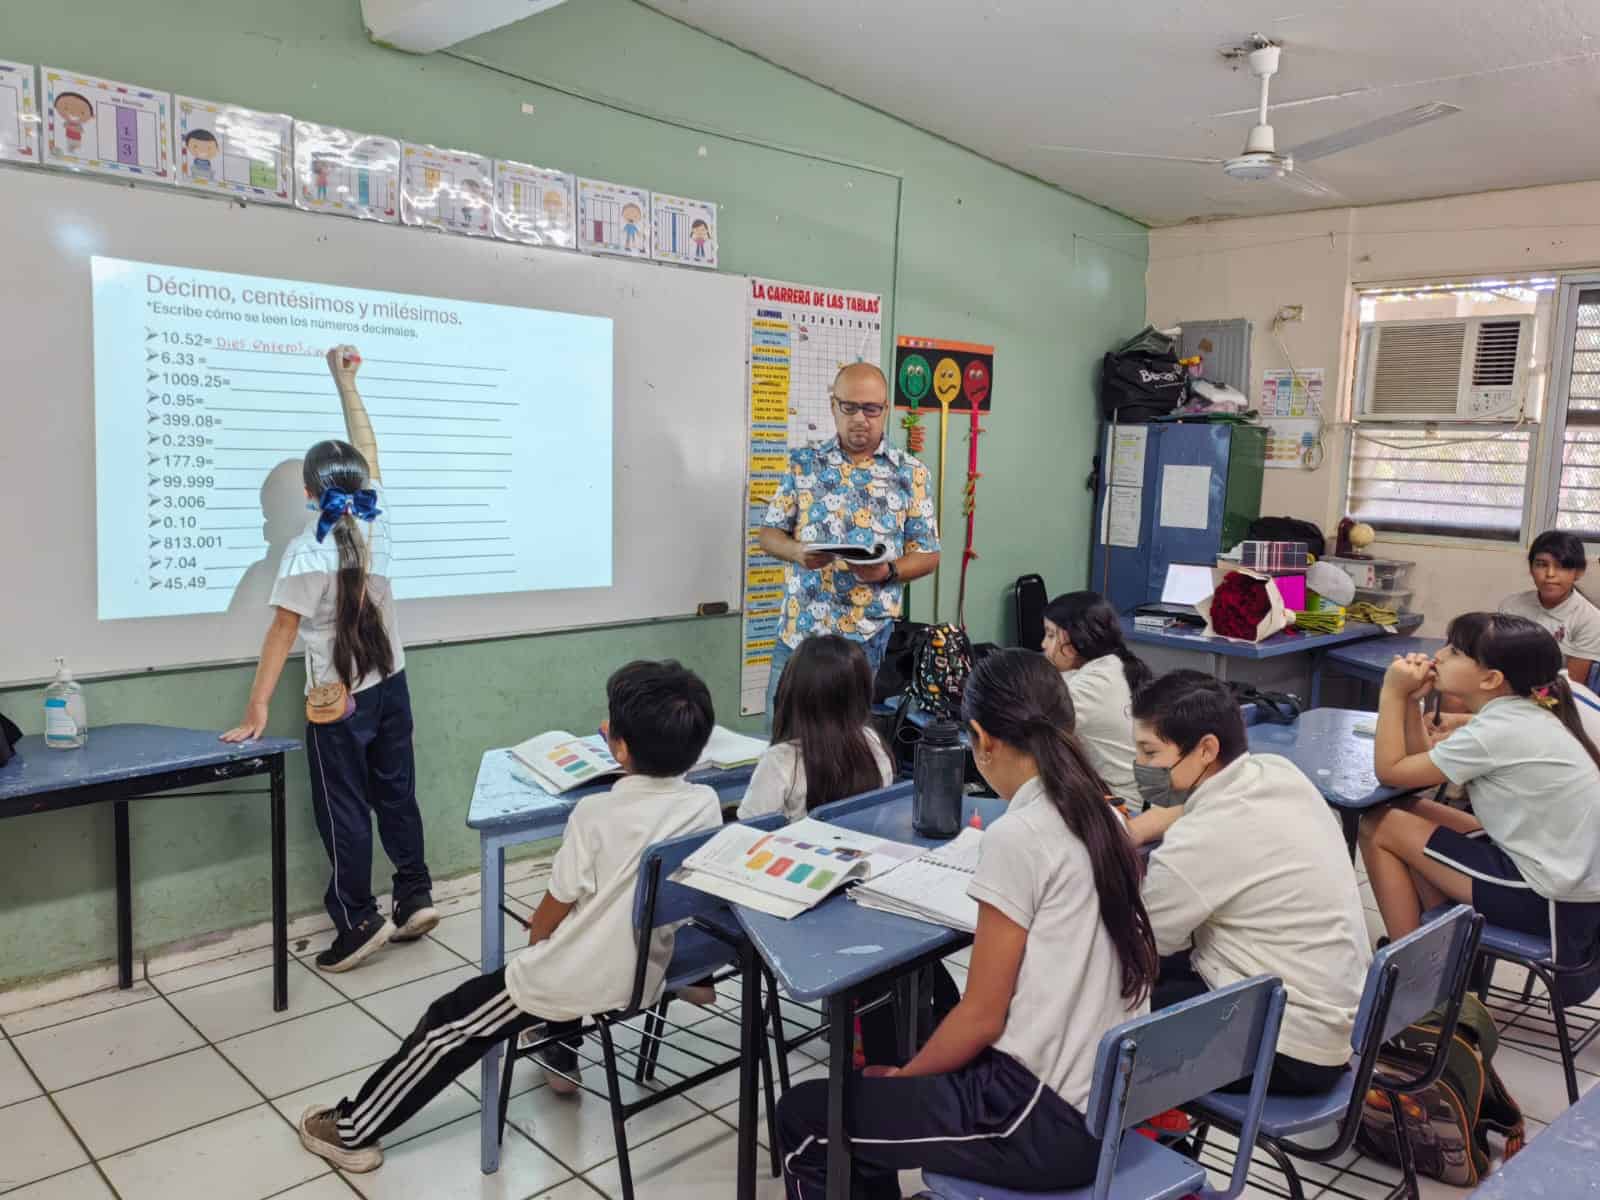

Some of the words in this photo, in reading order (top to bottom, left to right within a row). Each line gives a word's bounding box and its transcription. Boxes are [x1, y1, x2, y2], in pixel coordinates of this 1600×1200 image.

[146, 275, 236, 304] Décimo,
[242, 288, 355, 314] centésimos
[359, 301, 369, 319] y
[373, 301, 463, 325] milésimos.
[753, 284, 766, 300] LA
[767, 286, 810, 306] CARRERA
[813, 292, 825, 307] DE
[827, 294, 844, 310] LAS
[846, 297, 878, 313] TABLAS
[205, 308, 241, 321] cómo
[244, 314, 260, 323] se
[262, 312, 288, 326] leen
[290, 315, 309, 327] los
[311, 316, 360, 332] números
[362, 322, 419, 338] decimales.
[162, 331, 212, 347] 10.52=
[162, 352, 194, 366] 6.33
[162, 372, 231, 389] 1009.25=
[162, 392, 204, 408] 0.95=
[162, 412, 223, 428] 399.08=
[163, 434, 214, 448] 0.239=
[163, 455, 214, 469] 177.9=
[163, 475, 214, 489] 99.999
[163, 495, 206, 509] 3.006
[163, 516, 197, 530] 0.10
[163, 536, 223, 550] 813.001
[163, 556, 197, 570] 7.04
[163, 576, 206, 591] 45.49
